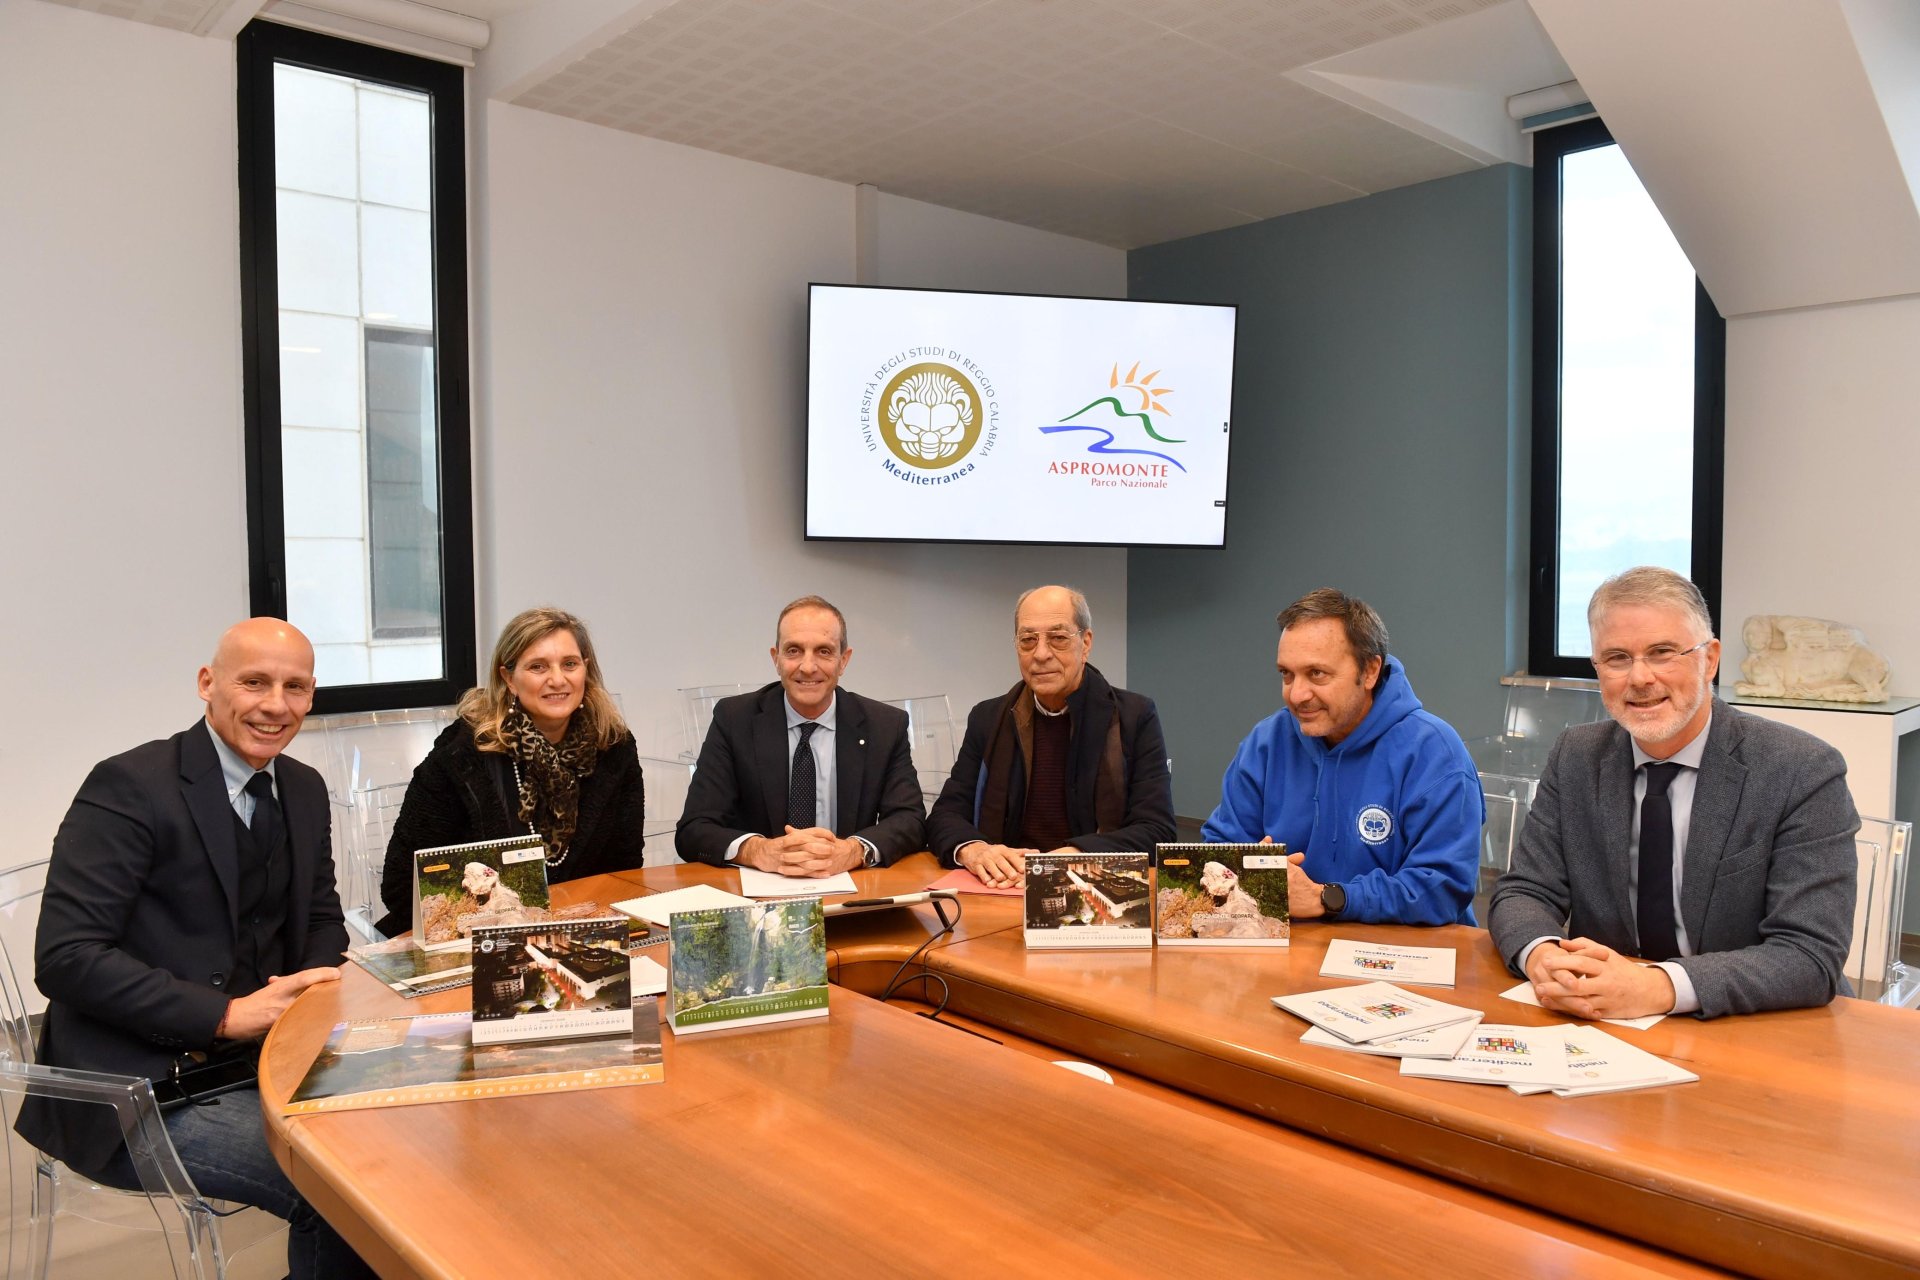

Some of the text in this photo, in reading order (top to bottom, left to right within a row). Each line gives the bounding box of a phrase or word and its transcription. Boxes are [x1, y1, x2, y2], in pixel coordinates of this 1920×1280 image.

[861, 346, 999, 457] UNIVERSITÀ DEGLI STUDI DI REGGIO CALABRIA
[882, 458, 976, 486] Mediterranea
[1048, 461, 1169, 478] ASPROMONTE
[1091, 477, 1168, 489] Parco Nazionale
[1453, 1056, 1532, 1067] mediterran
